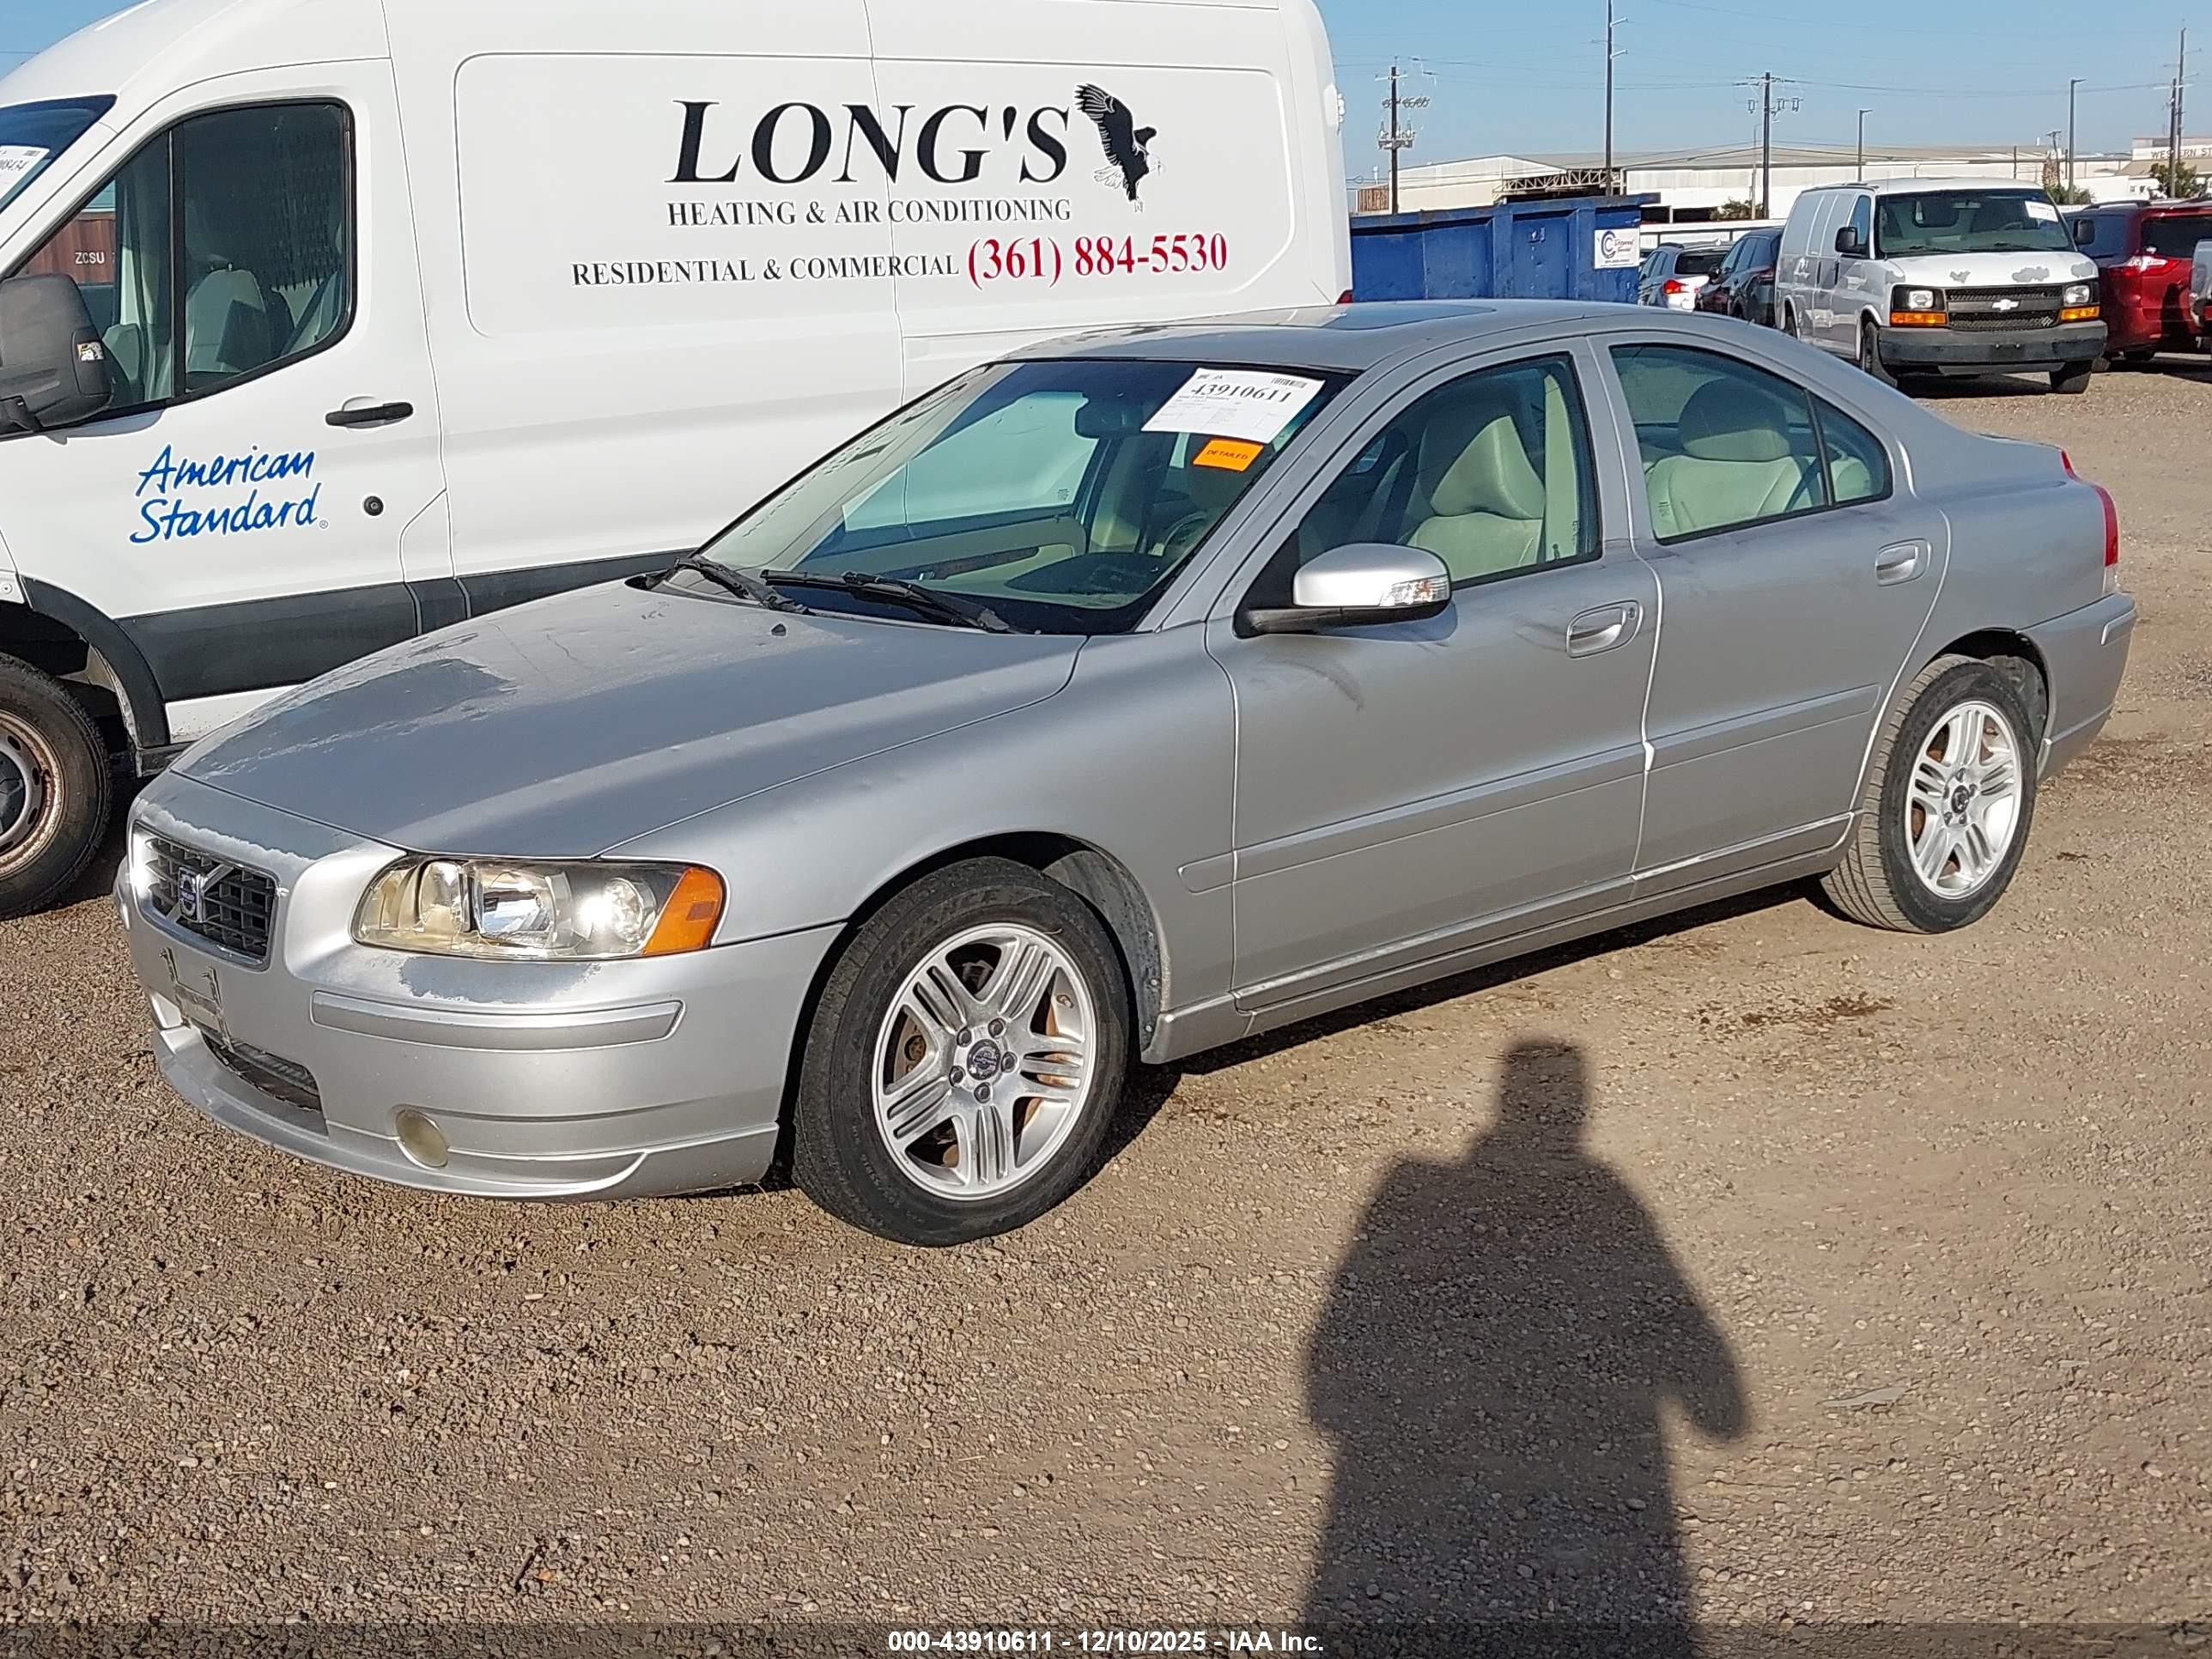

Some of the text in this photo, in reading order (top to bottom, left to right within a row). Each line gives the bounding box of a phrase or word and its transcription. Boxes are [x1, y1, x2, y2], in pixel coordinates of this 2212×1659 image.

[664, 100, 1070, 184] LONG'S
[666, 198, 1071, 226] HEATING & AIR CONDITIONING
[75, 252, 105, 264] ZCSU
[570, 233, 1228, 290] RESIDENTIAL & COMMERCIAL (361) 884-5530
[1191, 383, 1291, 403] 43910611
[1206, 449, 1249, 460] DETAILED
[135, 443, 315, 497] American
